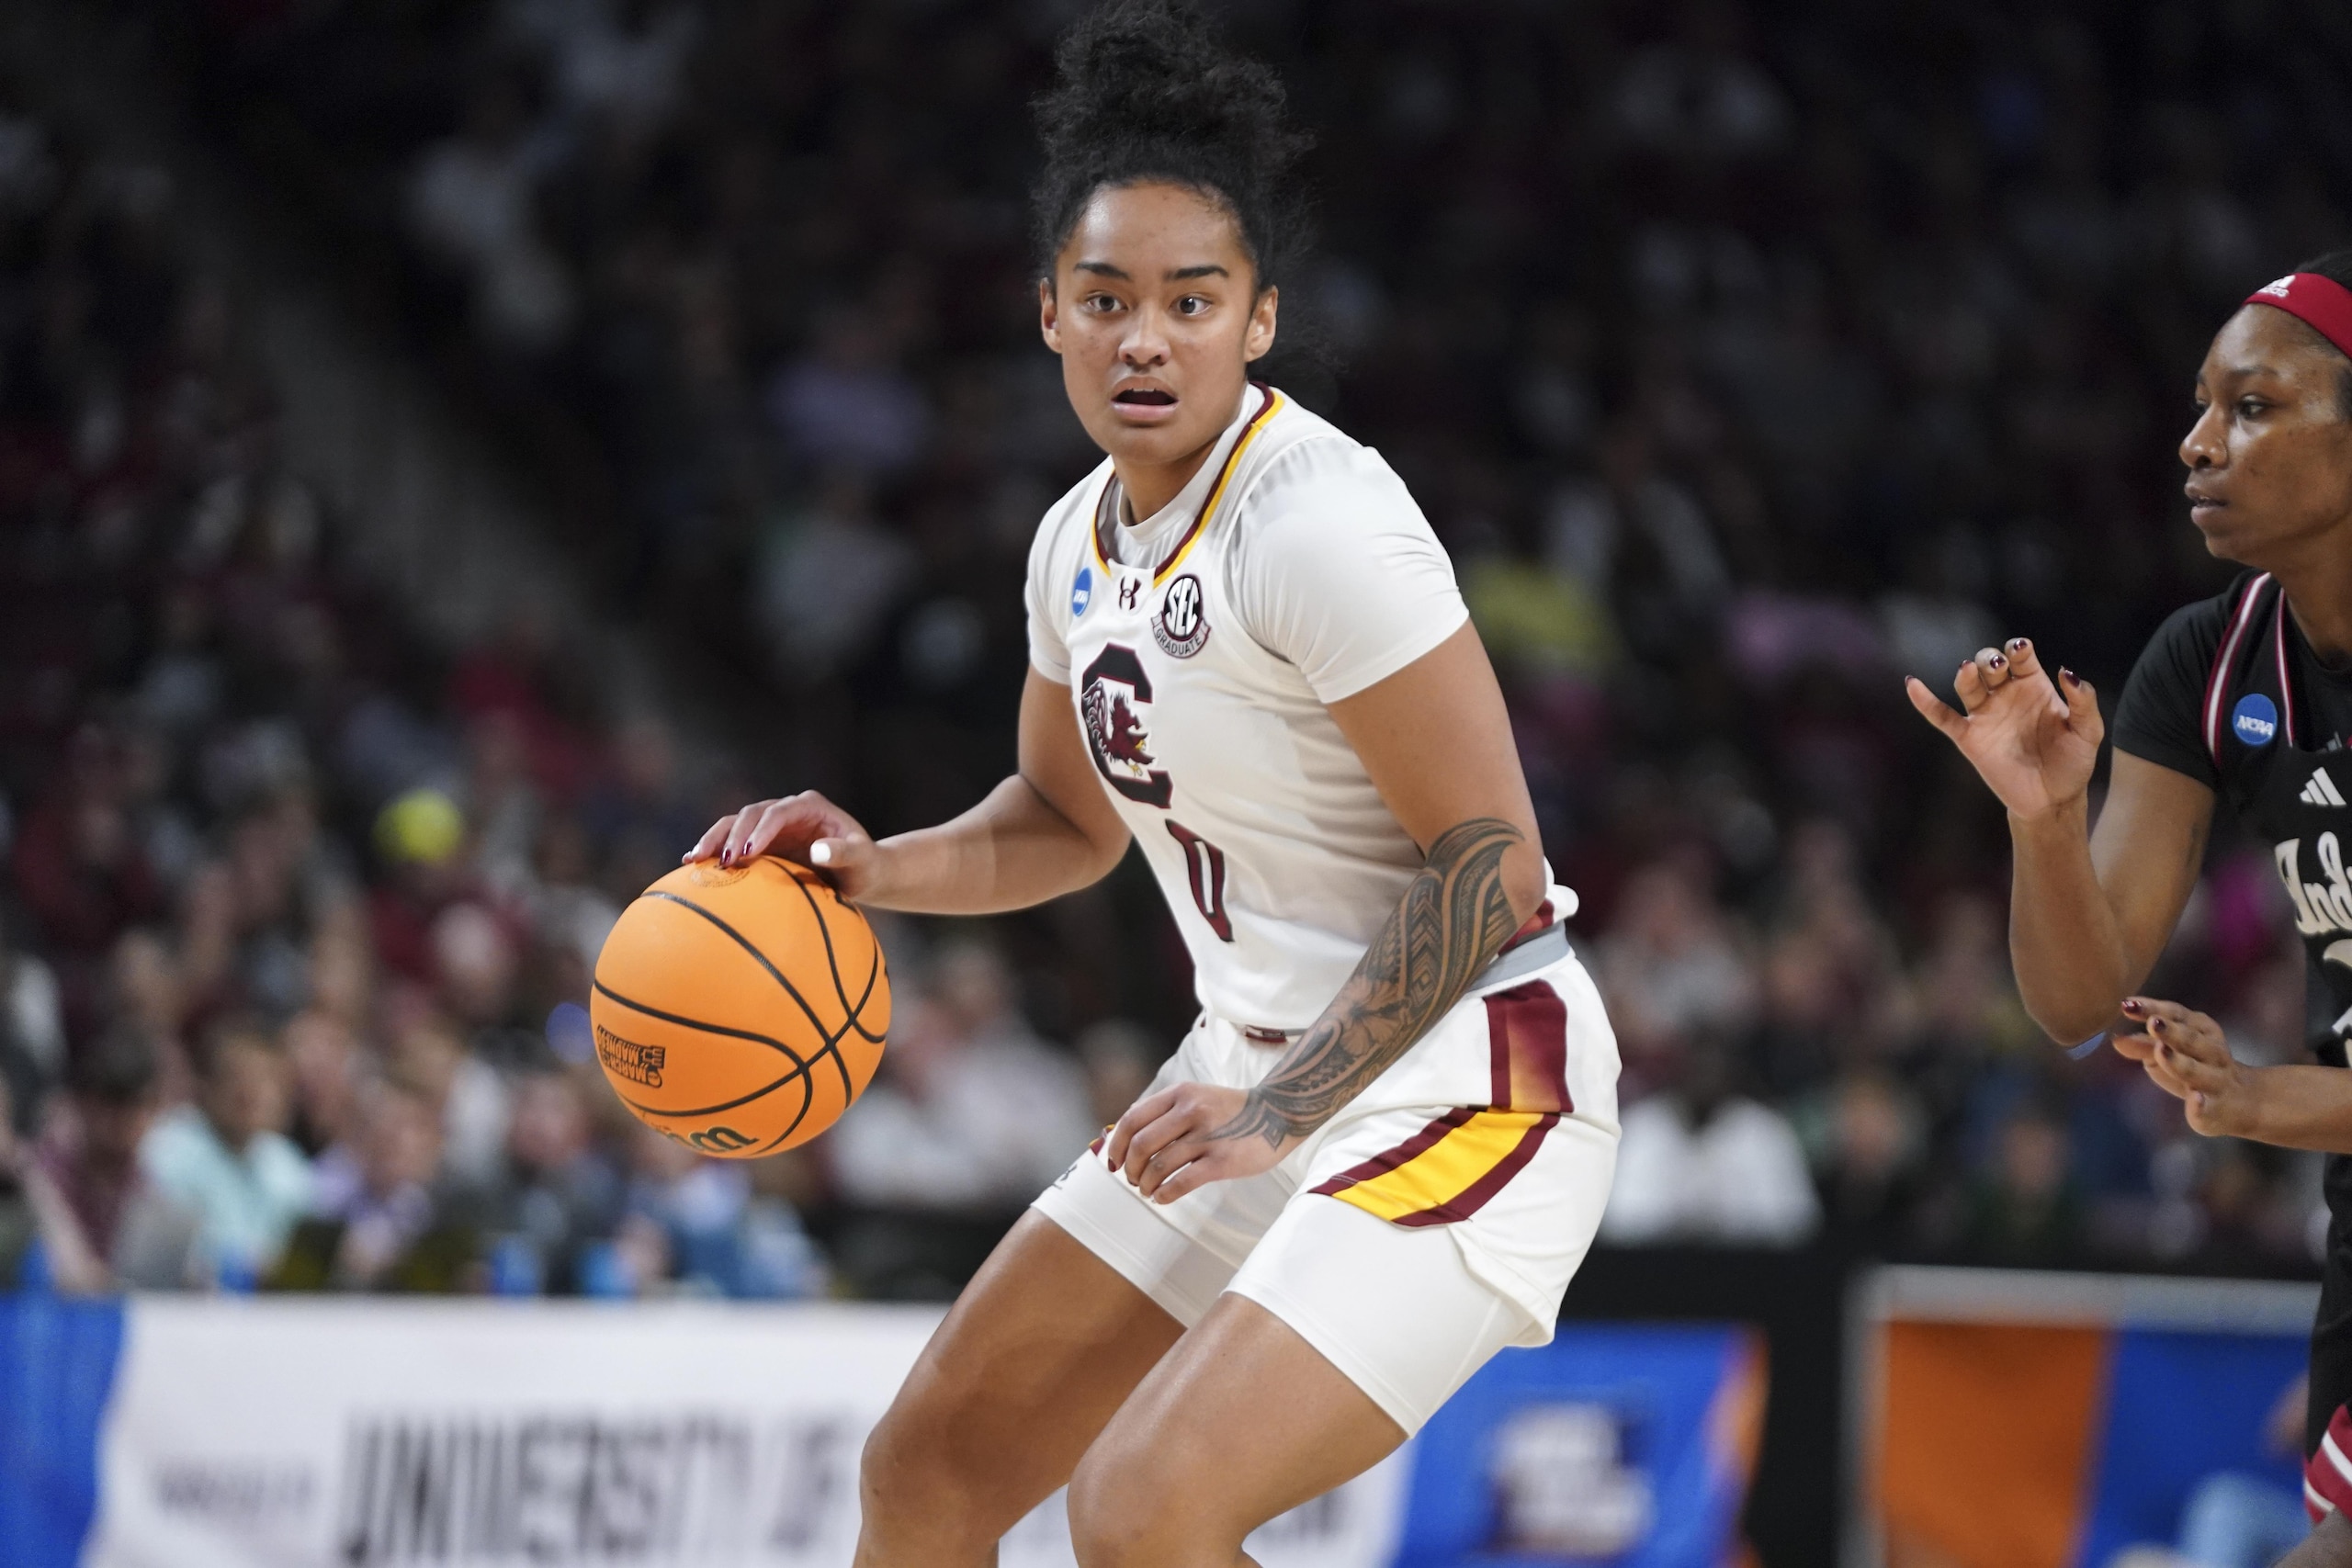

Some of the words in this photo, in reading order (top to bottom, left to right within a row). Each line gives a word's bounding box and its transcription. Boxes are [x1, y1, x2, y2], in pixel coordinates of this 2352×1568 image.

[1164, 577, 1200, 637] SEC
[1156, 627, 1203, 656] GRADUATE
[1081, 641, 1174, 809] C
[2236, 715, 2274, 736] NCAA
[1165, 818, 1235, 942] 0
